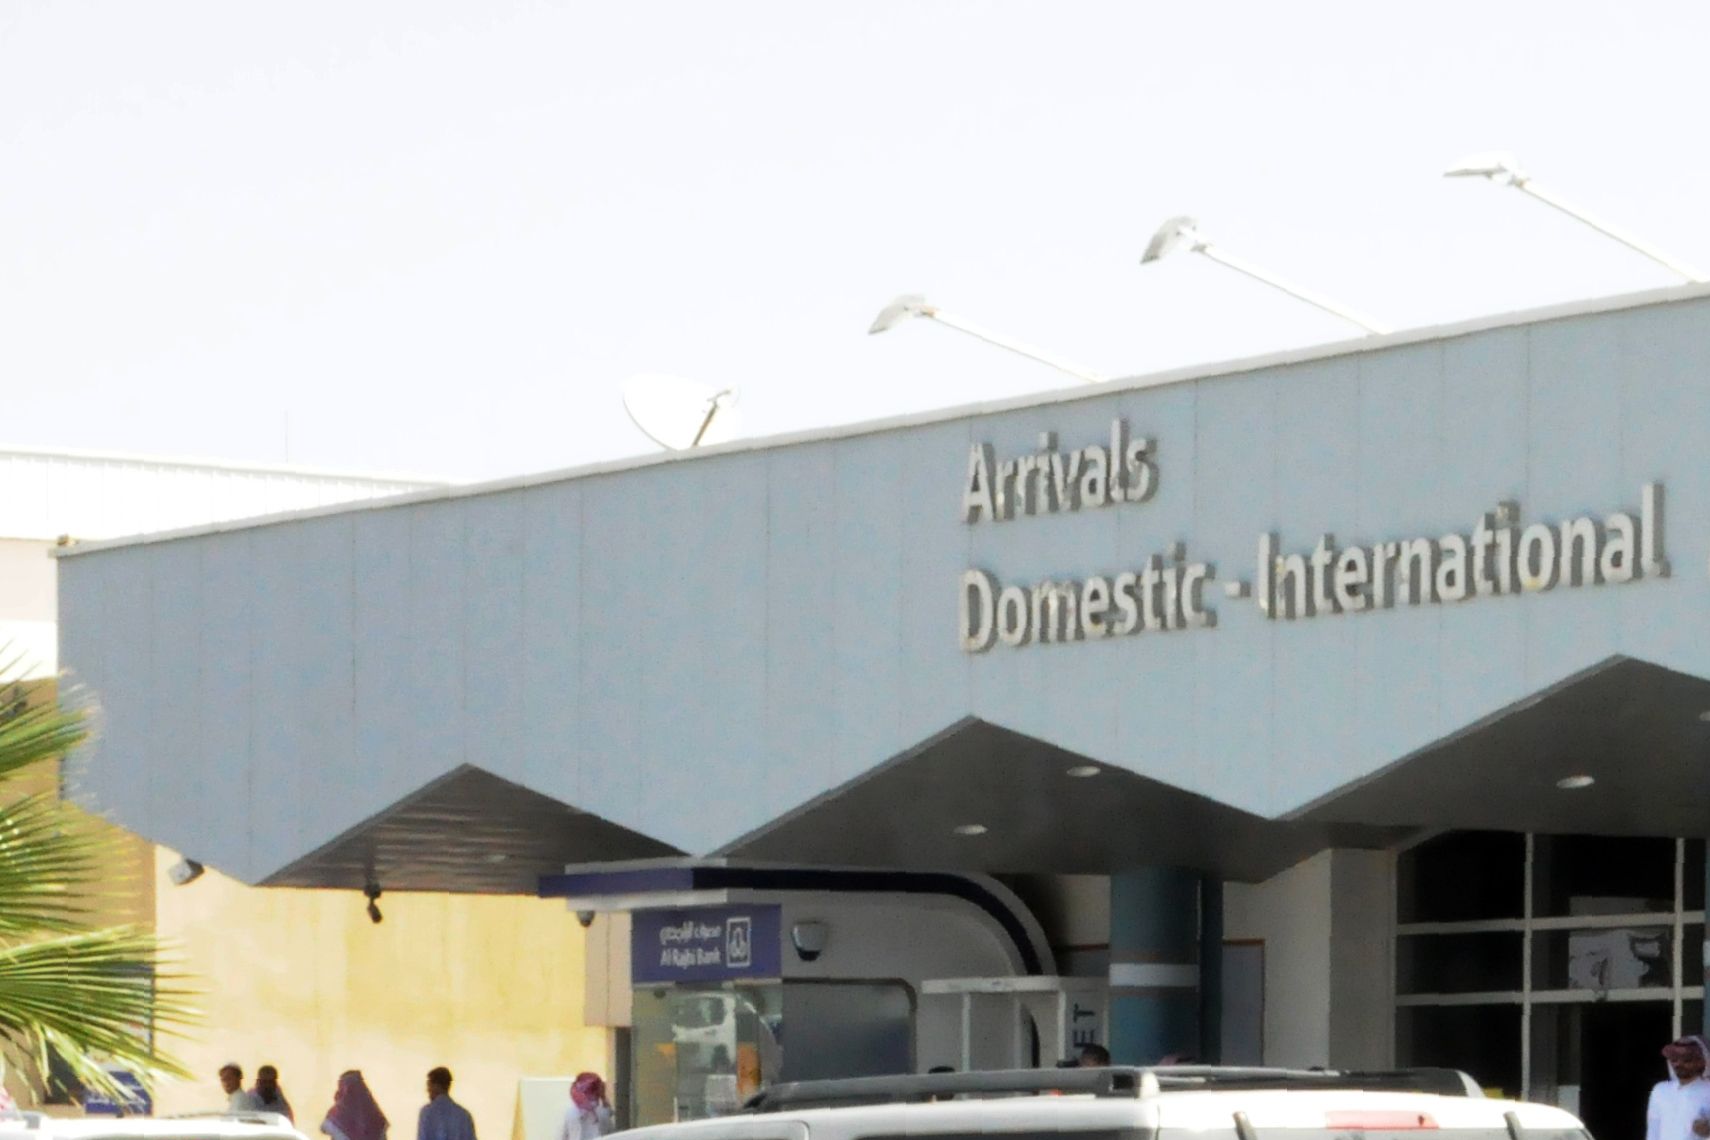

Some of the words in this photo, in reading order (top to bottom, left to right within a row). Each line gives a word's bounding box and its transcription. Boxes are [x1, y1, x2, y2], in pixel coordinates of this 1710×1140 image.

[962, 417, 1158, 525] Arrivals
[960, 541, 1218, 654] Domestic
[1258, 481, 1672, 621] International
